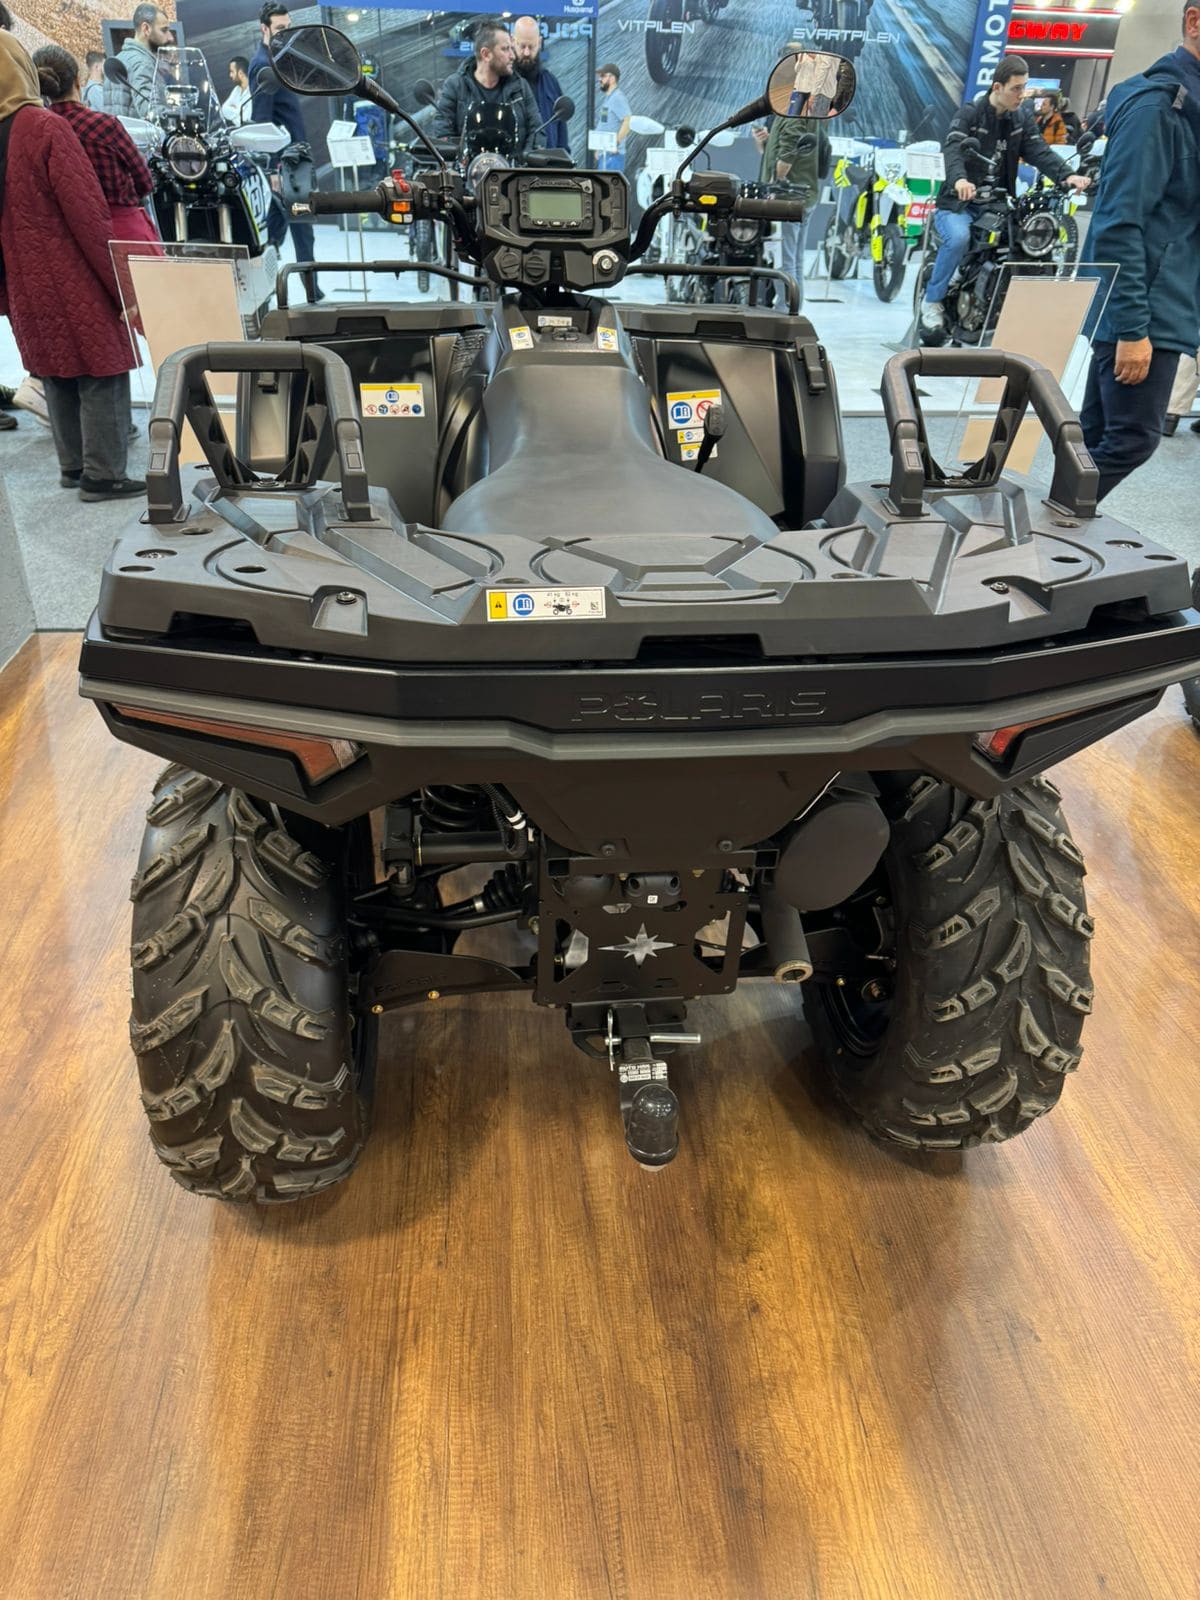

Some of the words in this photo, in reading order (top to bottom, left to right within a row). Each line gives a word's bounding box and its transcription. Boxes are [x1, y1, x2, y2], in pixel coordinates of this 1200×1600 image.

[617, 19, 695, 34] VITPILEN
[792, 28, 900, 43] SVARTPILEN
[571, 691, 826, 721] POLARIS
